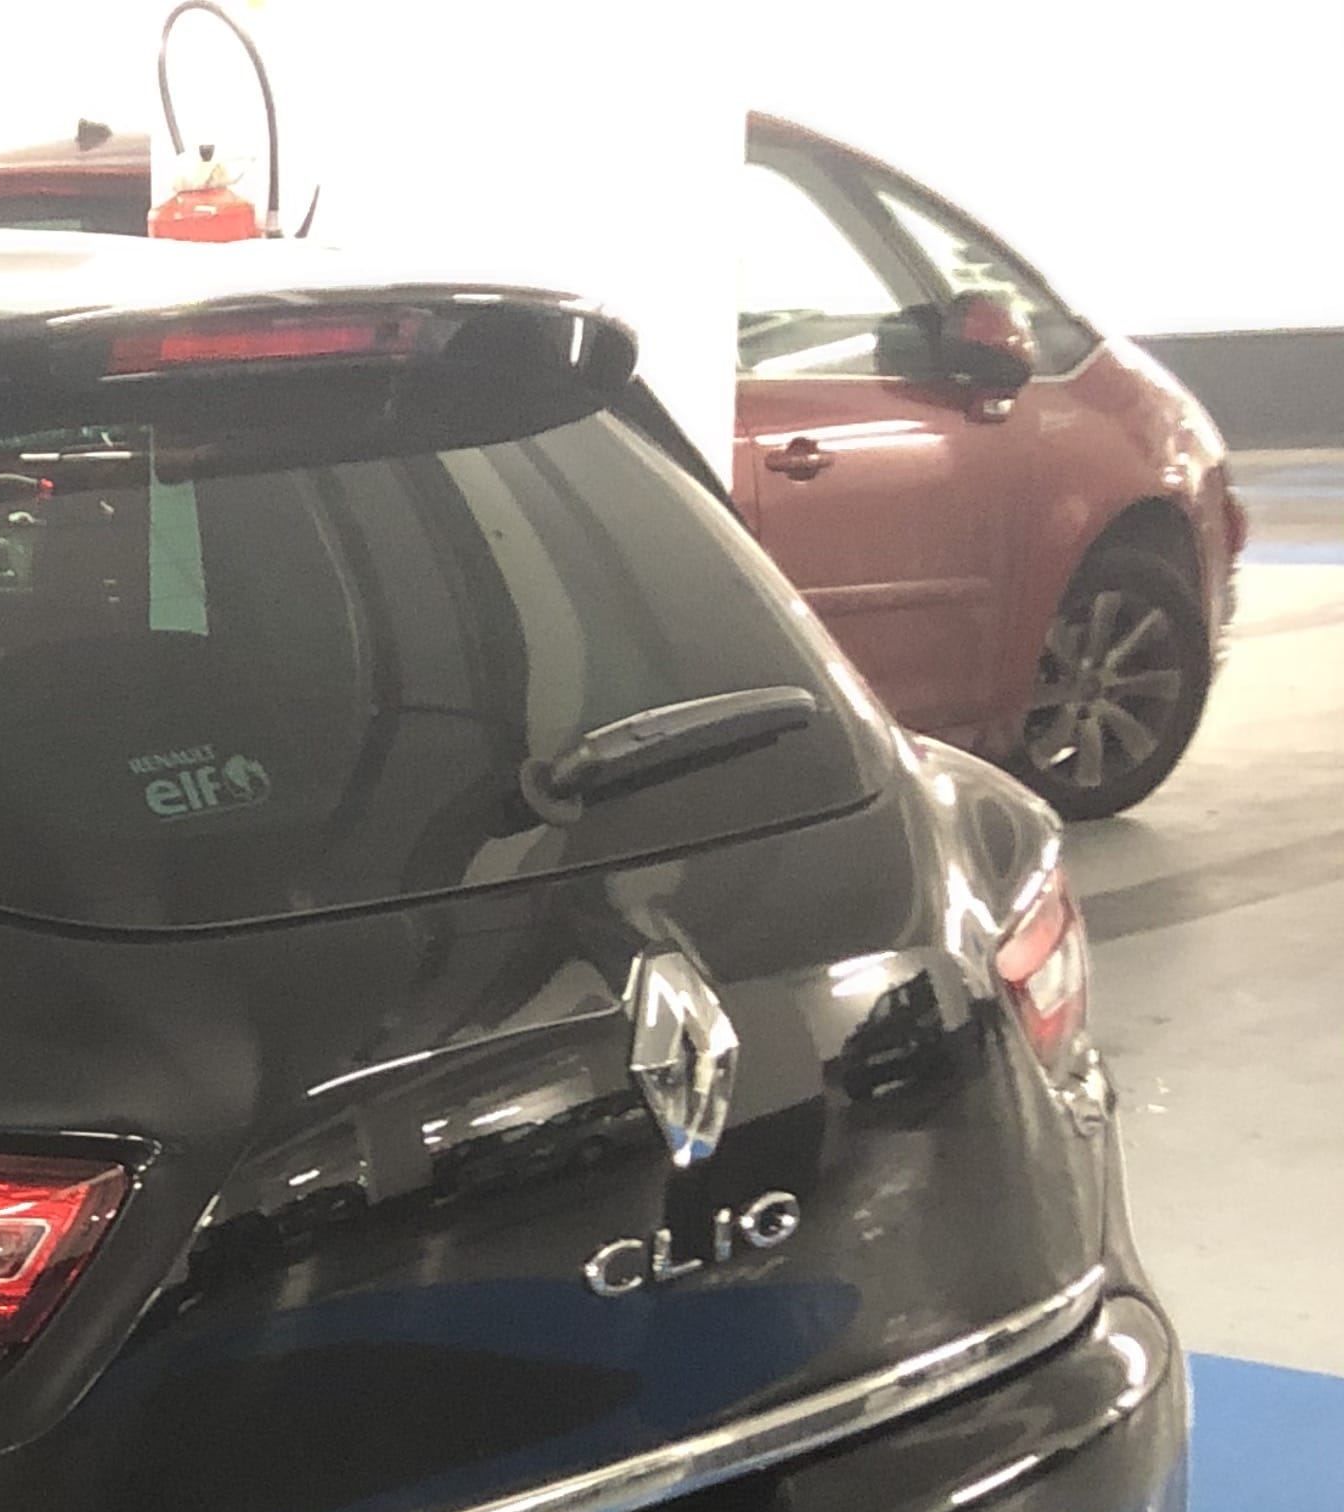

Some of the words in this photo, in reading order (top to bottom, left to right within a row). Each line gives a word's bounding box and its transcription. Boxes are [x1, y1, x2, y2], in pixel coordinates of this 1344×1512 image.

[128, 744, 215, 774] RENAULT
[145, 765, 221, 816] elf
[583, 1190, 801, 1296] CLIO
